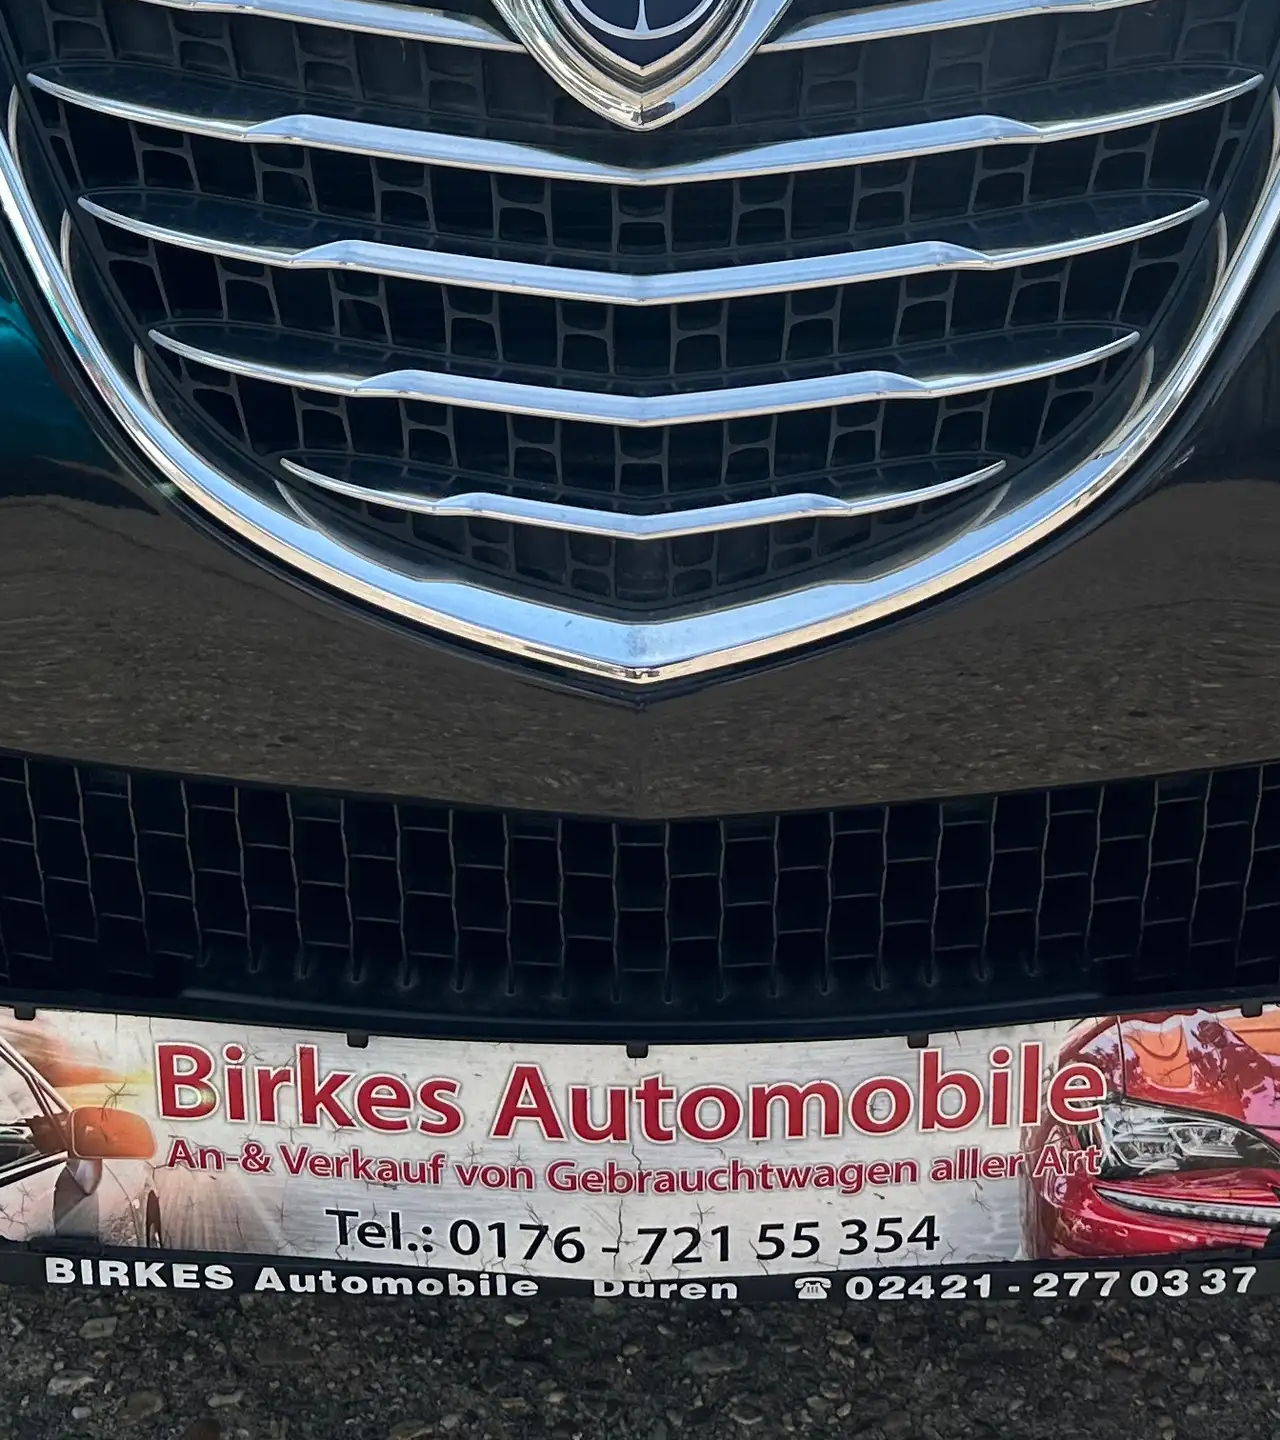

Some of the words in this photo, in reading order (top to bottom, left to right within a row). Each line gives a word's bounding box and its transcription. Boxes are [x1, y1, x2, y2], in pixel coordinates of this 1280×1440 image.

[155, 1041, 465, 1137] Birkes
[490, 1041, 1107, 1145] Automobile
[278, 1145, 445, 1185] Verkauf
[456, 1163, 534, 1190] von
[545, 1159, 920, 1197] Gebrauchtwagen
[929, 1147, 1024, 1183] aller
[1034, 1143, 1103, 1177] Art
[325, 1208, 434, 1253] Tel.:
[449, 1218, 586, 1263] 0176
[636, 1224, 730, 1265] 721
[756, 1221, 821, 1261] 55
[838, 1214, 941, 1258] 354
[45, 1256, 234, 1291] BIRKES
[254, 1266, 540, 1298] Automobile
[845, 1273, 992, 1302] 02421
